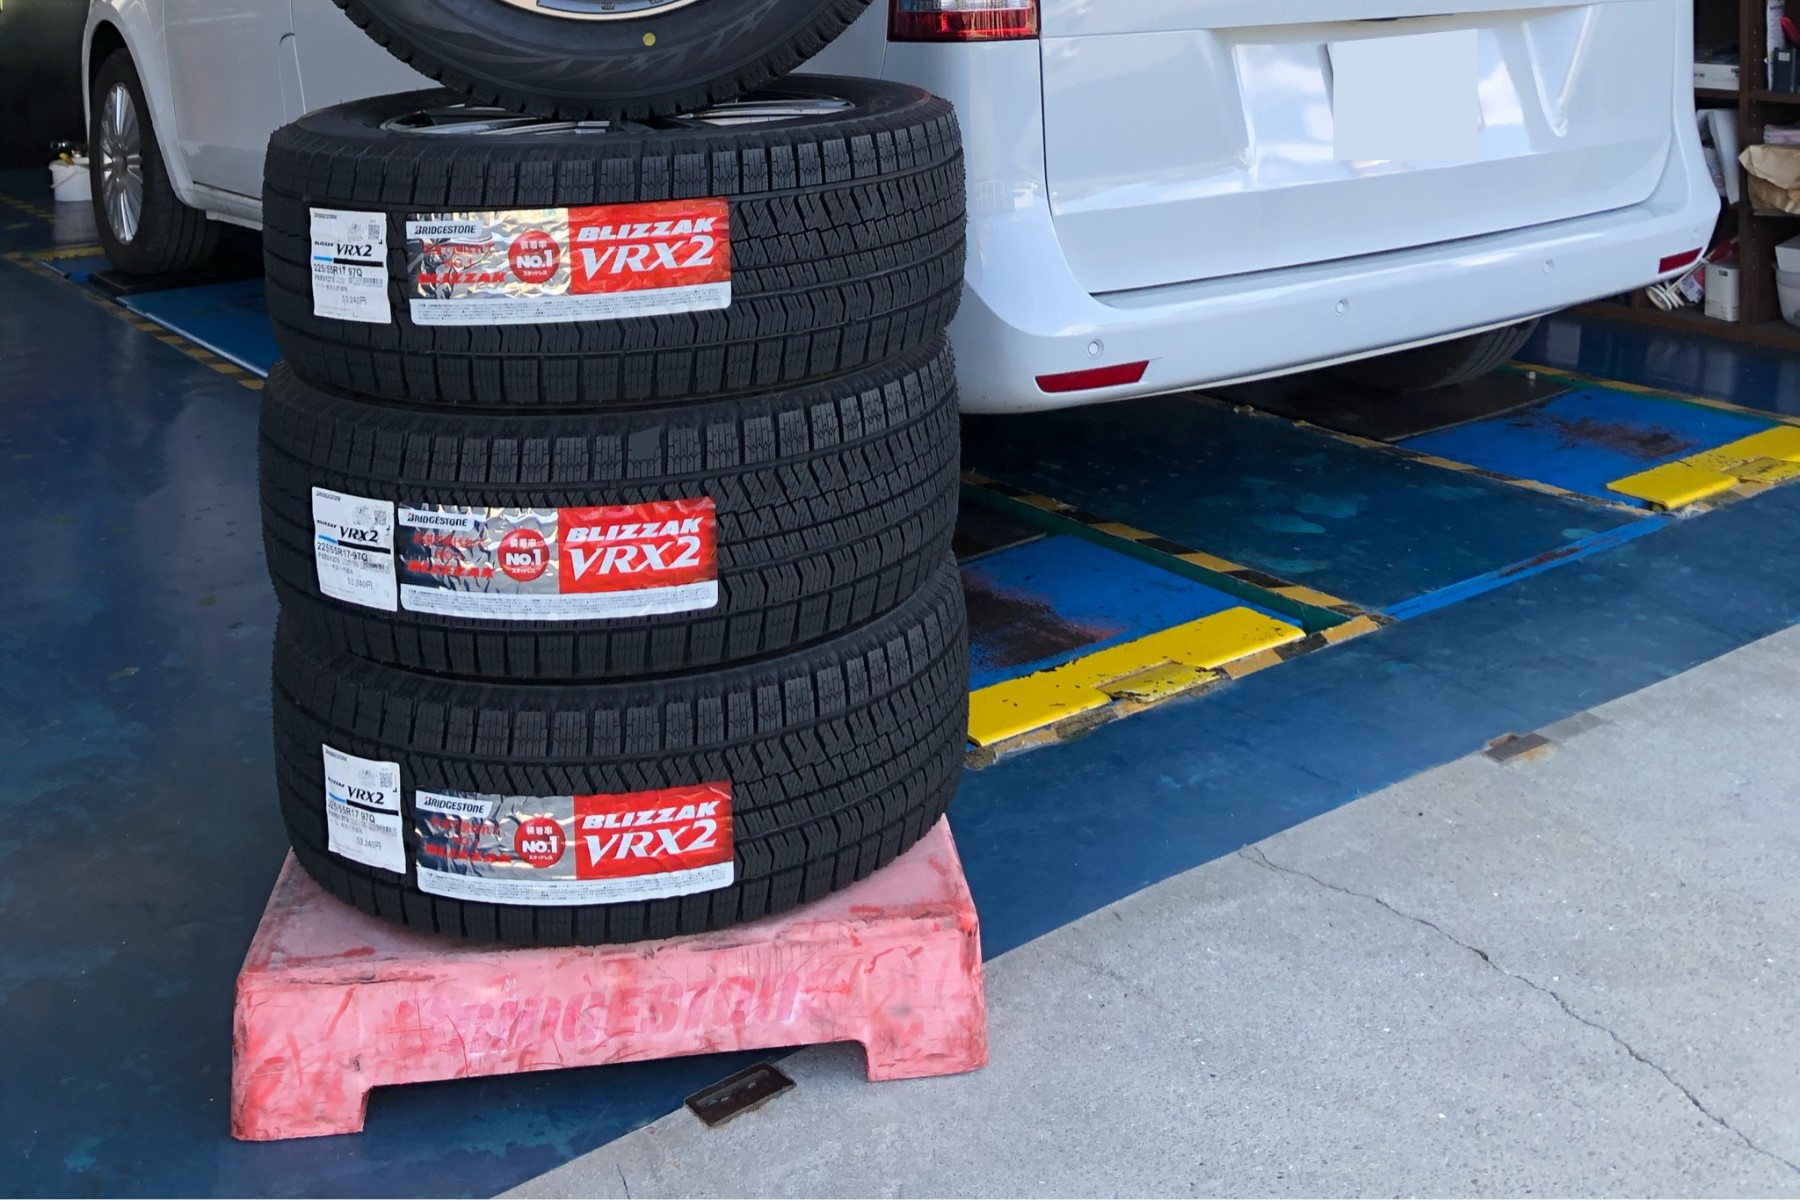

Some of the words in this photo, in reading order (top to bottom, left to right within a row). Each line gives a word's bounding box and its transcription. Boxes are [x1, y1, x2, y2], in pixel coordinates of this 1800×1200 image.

[414, 224, 477, 235] BRIDGESTONE
[576, 216, 718, 243] BLIZZAK
[336, 243, 373, 257] VRX2
[516, 249, 553, 269] NO.1
[578, 234, 716, 282] VRX2
[407, 512, 468, 527] BRIDGESTONE
[339, 525, 379, 543] VRX2
[565, 516, 704, 544] BLIZZAK
[505, 548, 543, 567] NO.1
[566, 535, 701, 582] VRX2
[346, 785, 384, 805] VRX2
[423, 795, 485, 814] BRIDGESTONE
[581, 800, 721, 830] BLIZZAK
[521, 835, 559, 854] NO.1
[583, 818, 718, 868] VRX2
